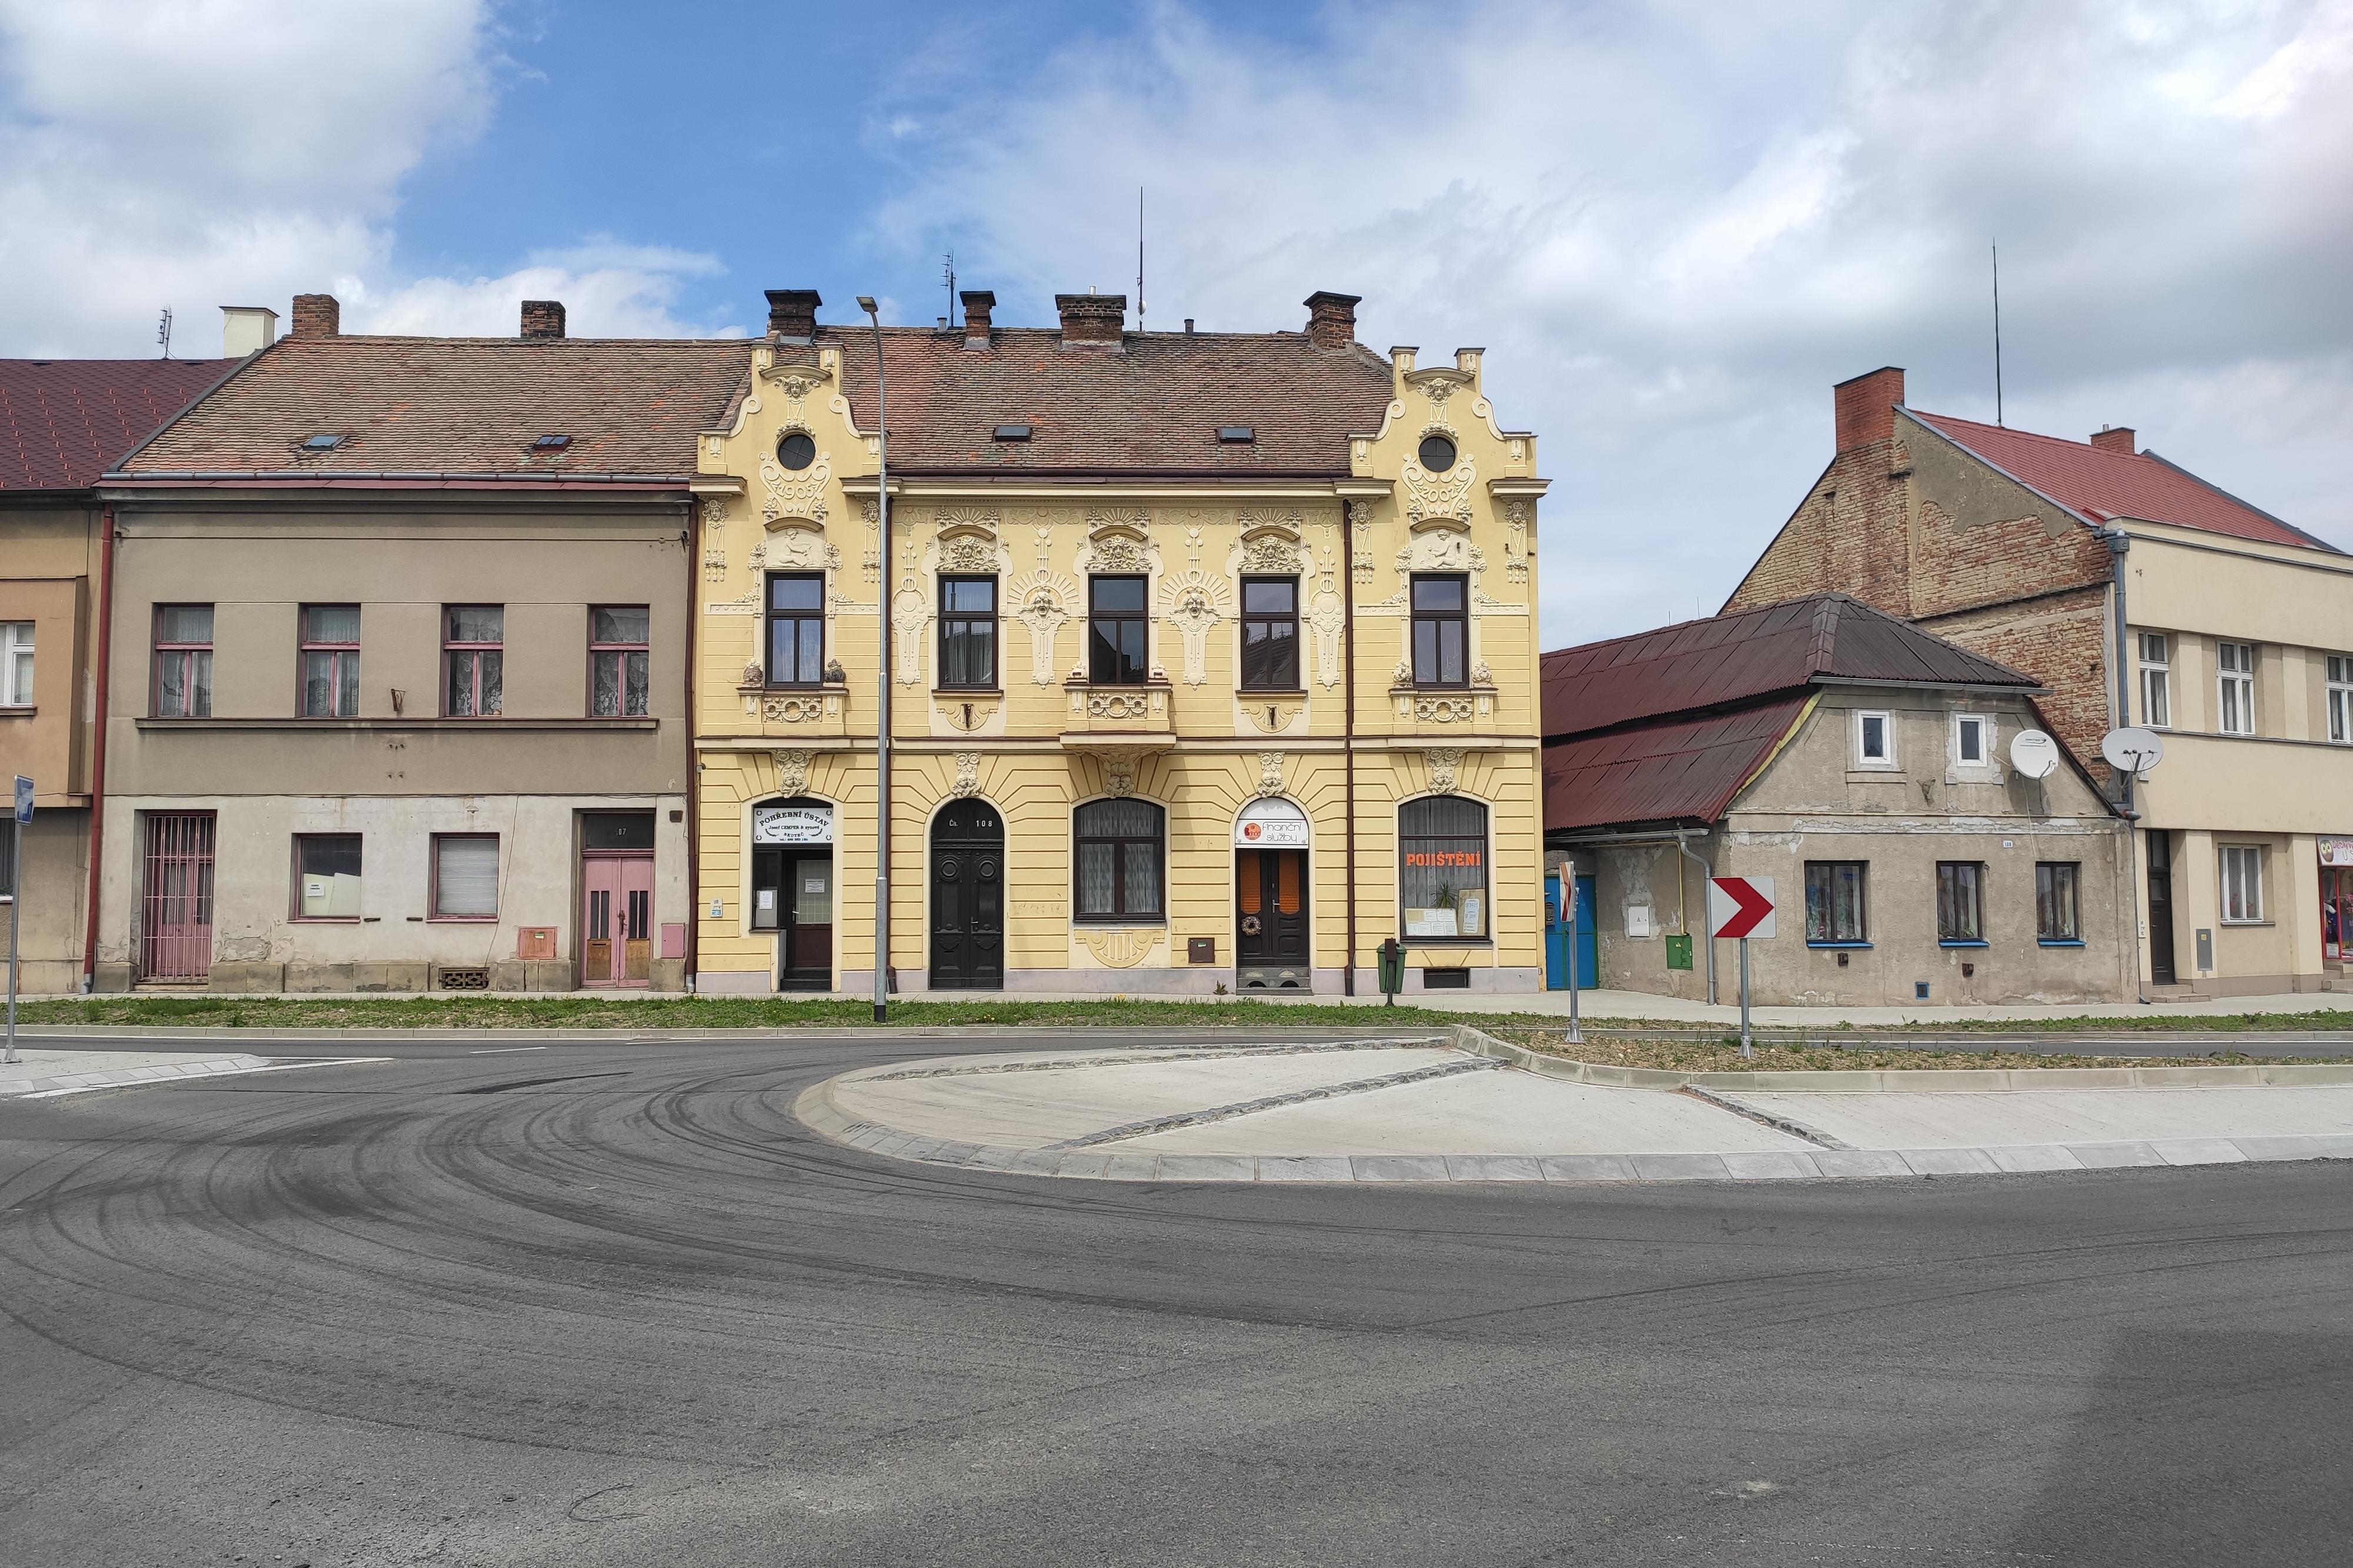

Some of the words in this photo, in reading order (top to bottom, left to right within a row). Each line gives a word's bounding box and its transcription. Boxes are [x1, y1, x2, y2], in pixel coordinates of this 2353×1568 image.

[775, 484, 815, 499] 1905
[1419, 486, 1459, 503] 2002
[759, 810, 802, 826] POHŘEBNÍ
[804, 812, 829, 826] ÚSTAV
[1262, 822, 1302, 832] Finanční
[1266, 833, 1297, 843] služby
[1406, 850, 1481, 866] POJIŠTĚNÍ
